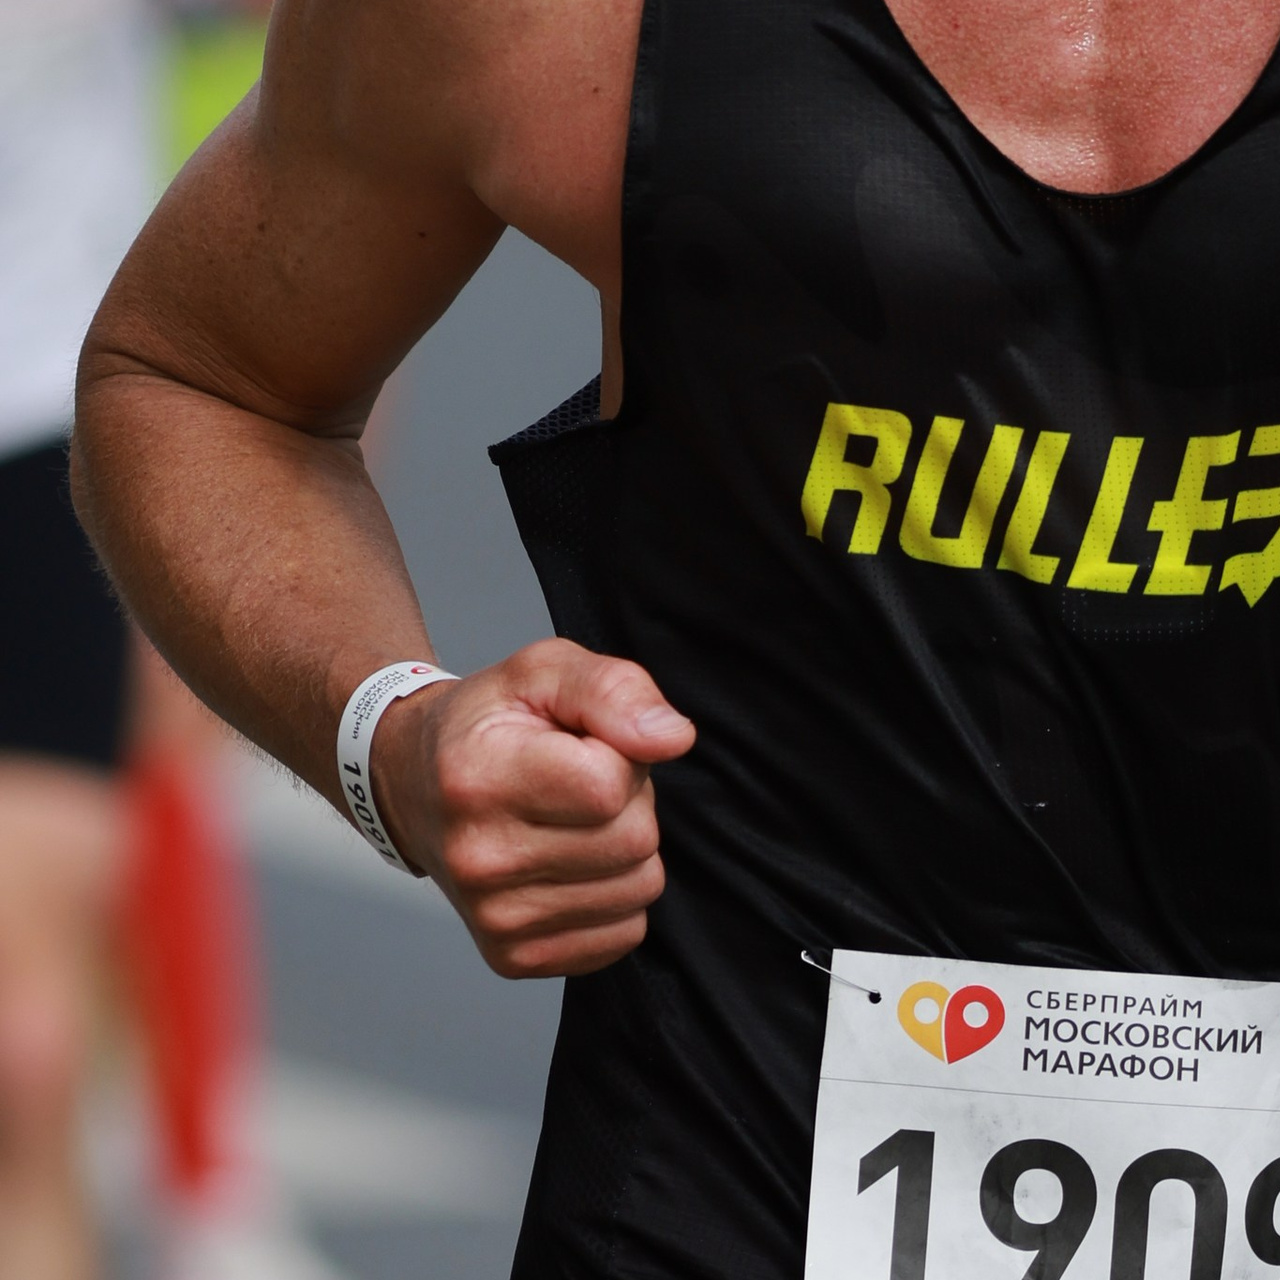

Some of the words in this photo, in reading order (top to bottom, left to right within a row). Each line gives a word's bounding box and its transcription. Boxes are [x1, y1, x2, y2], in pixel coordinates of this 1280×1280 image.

[352, 673, 405, 739] МОСКОВСКИЙ
[353, 671, 399, 716] МАРАФОН
[344, 761, 397, 860] 19091
[1026, 990, 1202, 1019] СБЕРПРАЙМ
[1024, 1016, 1262, 1054] МОСКОВСКИЙ
[1022, 1048, 1198, 1082] МАРАФОН
